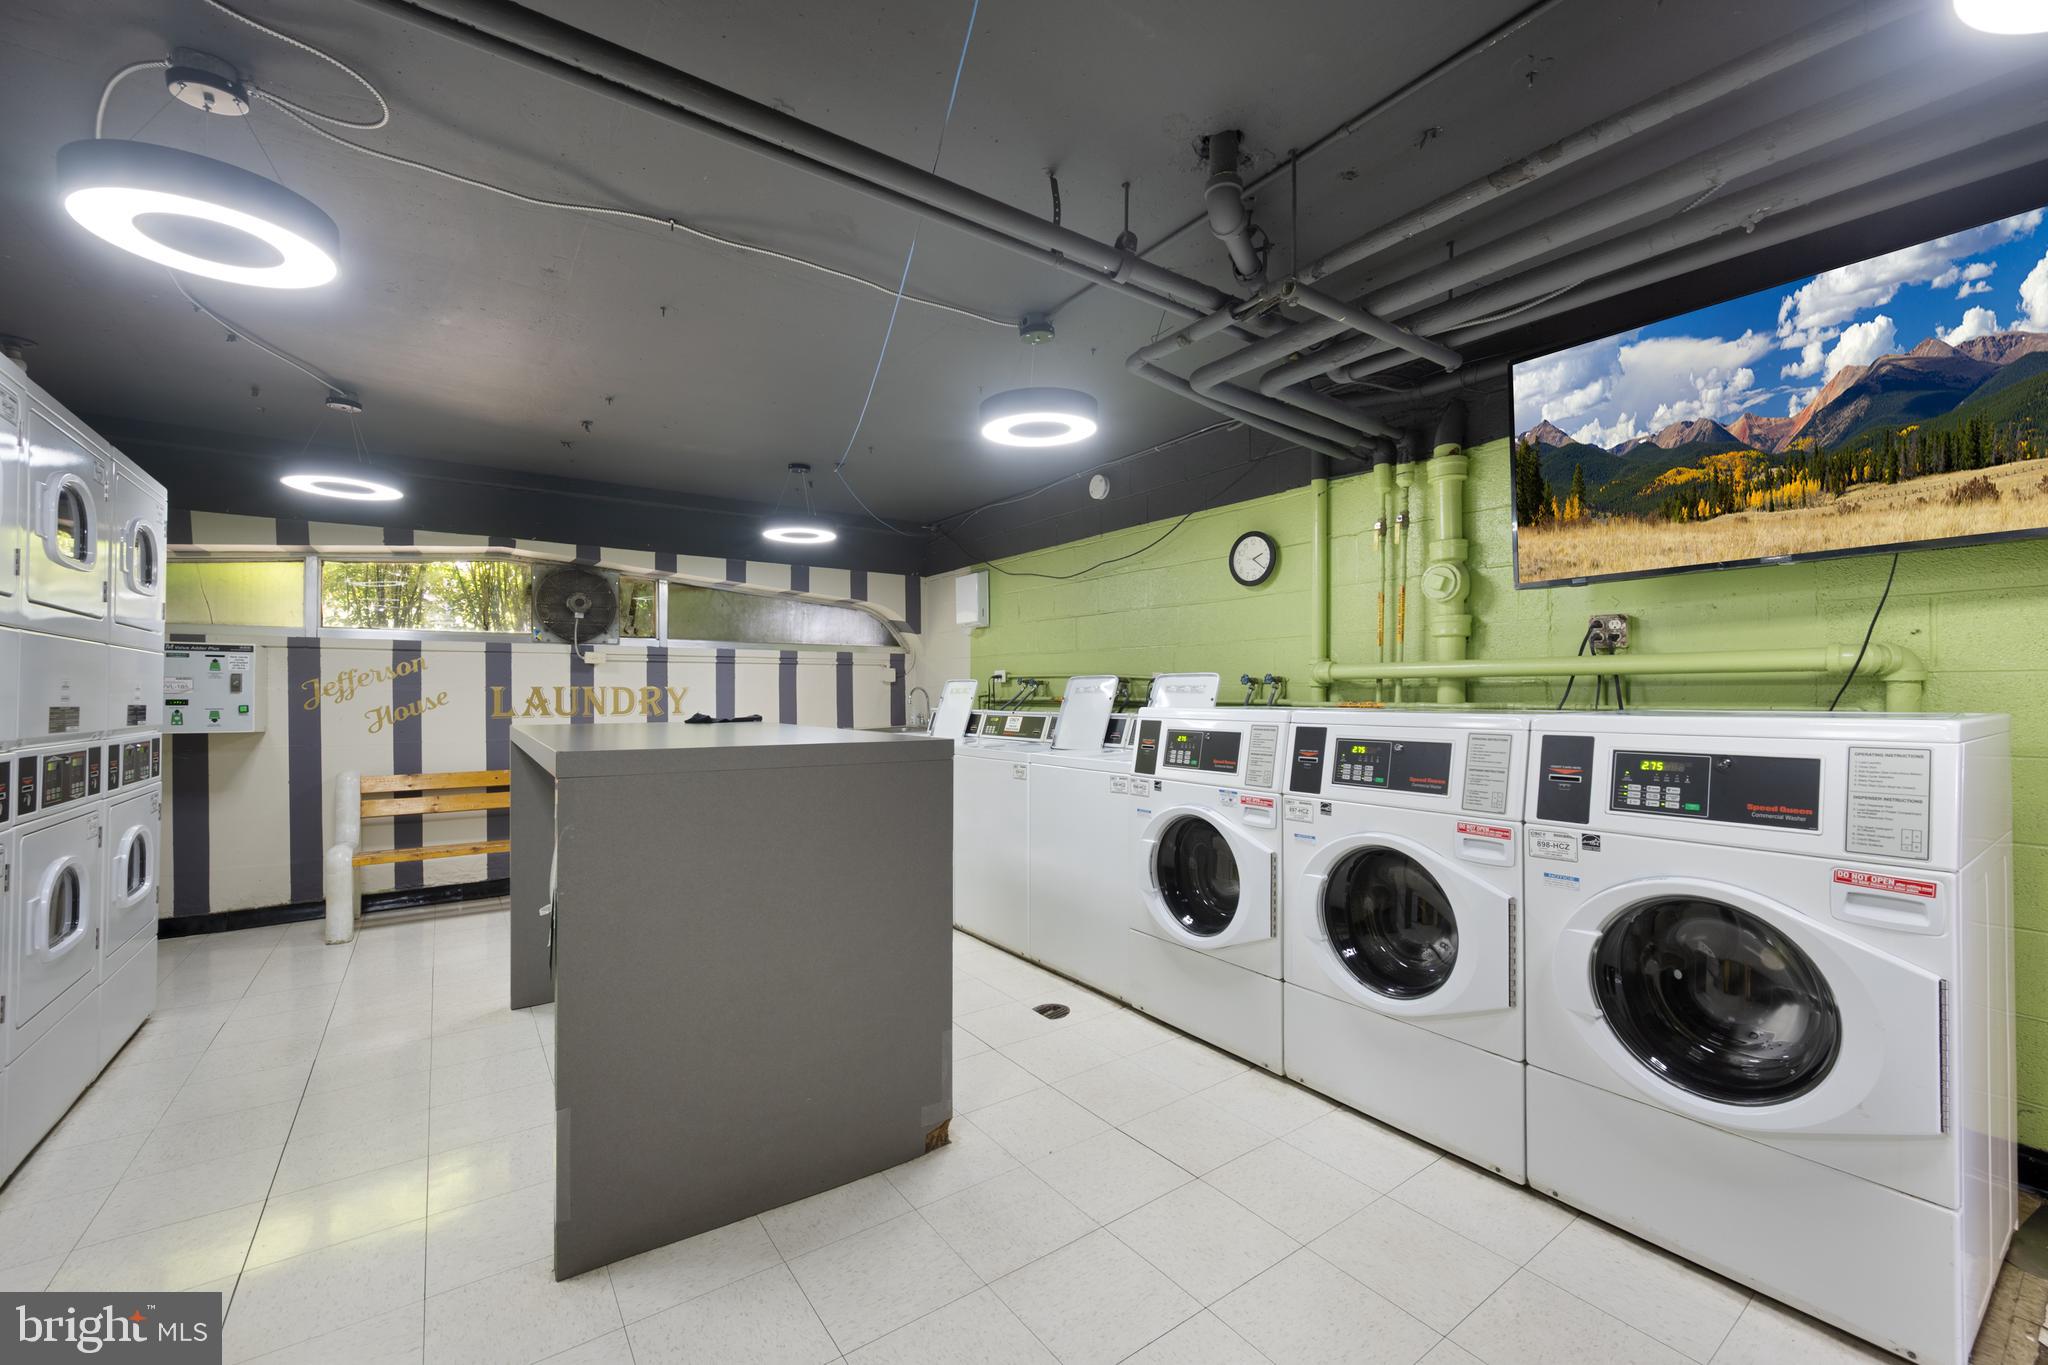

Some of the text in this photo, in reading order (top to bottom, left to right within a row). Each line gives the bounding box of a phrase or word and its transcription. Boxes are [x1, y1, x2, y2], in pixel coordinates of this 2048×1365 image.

[301, 655, 428, 710] Jefferson
[490, 685, 689, 719] LAUNDRY
[364, 689, 449, 734] House
[1746, 803, 1813, 815] Speed Queen
[1751, 811, 1807, 822] Commercial Washer
[1537, 840, 1570, 851] 898-HCZ
[1837, 870, 1849, 878] DO
[1851, 872, 1868, 881] NOT
[1871, 875, 1895, 886] OPEN
